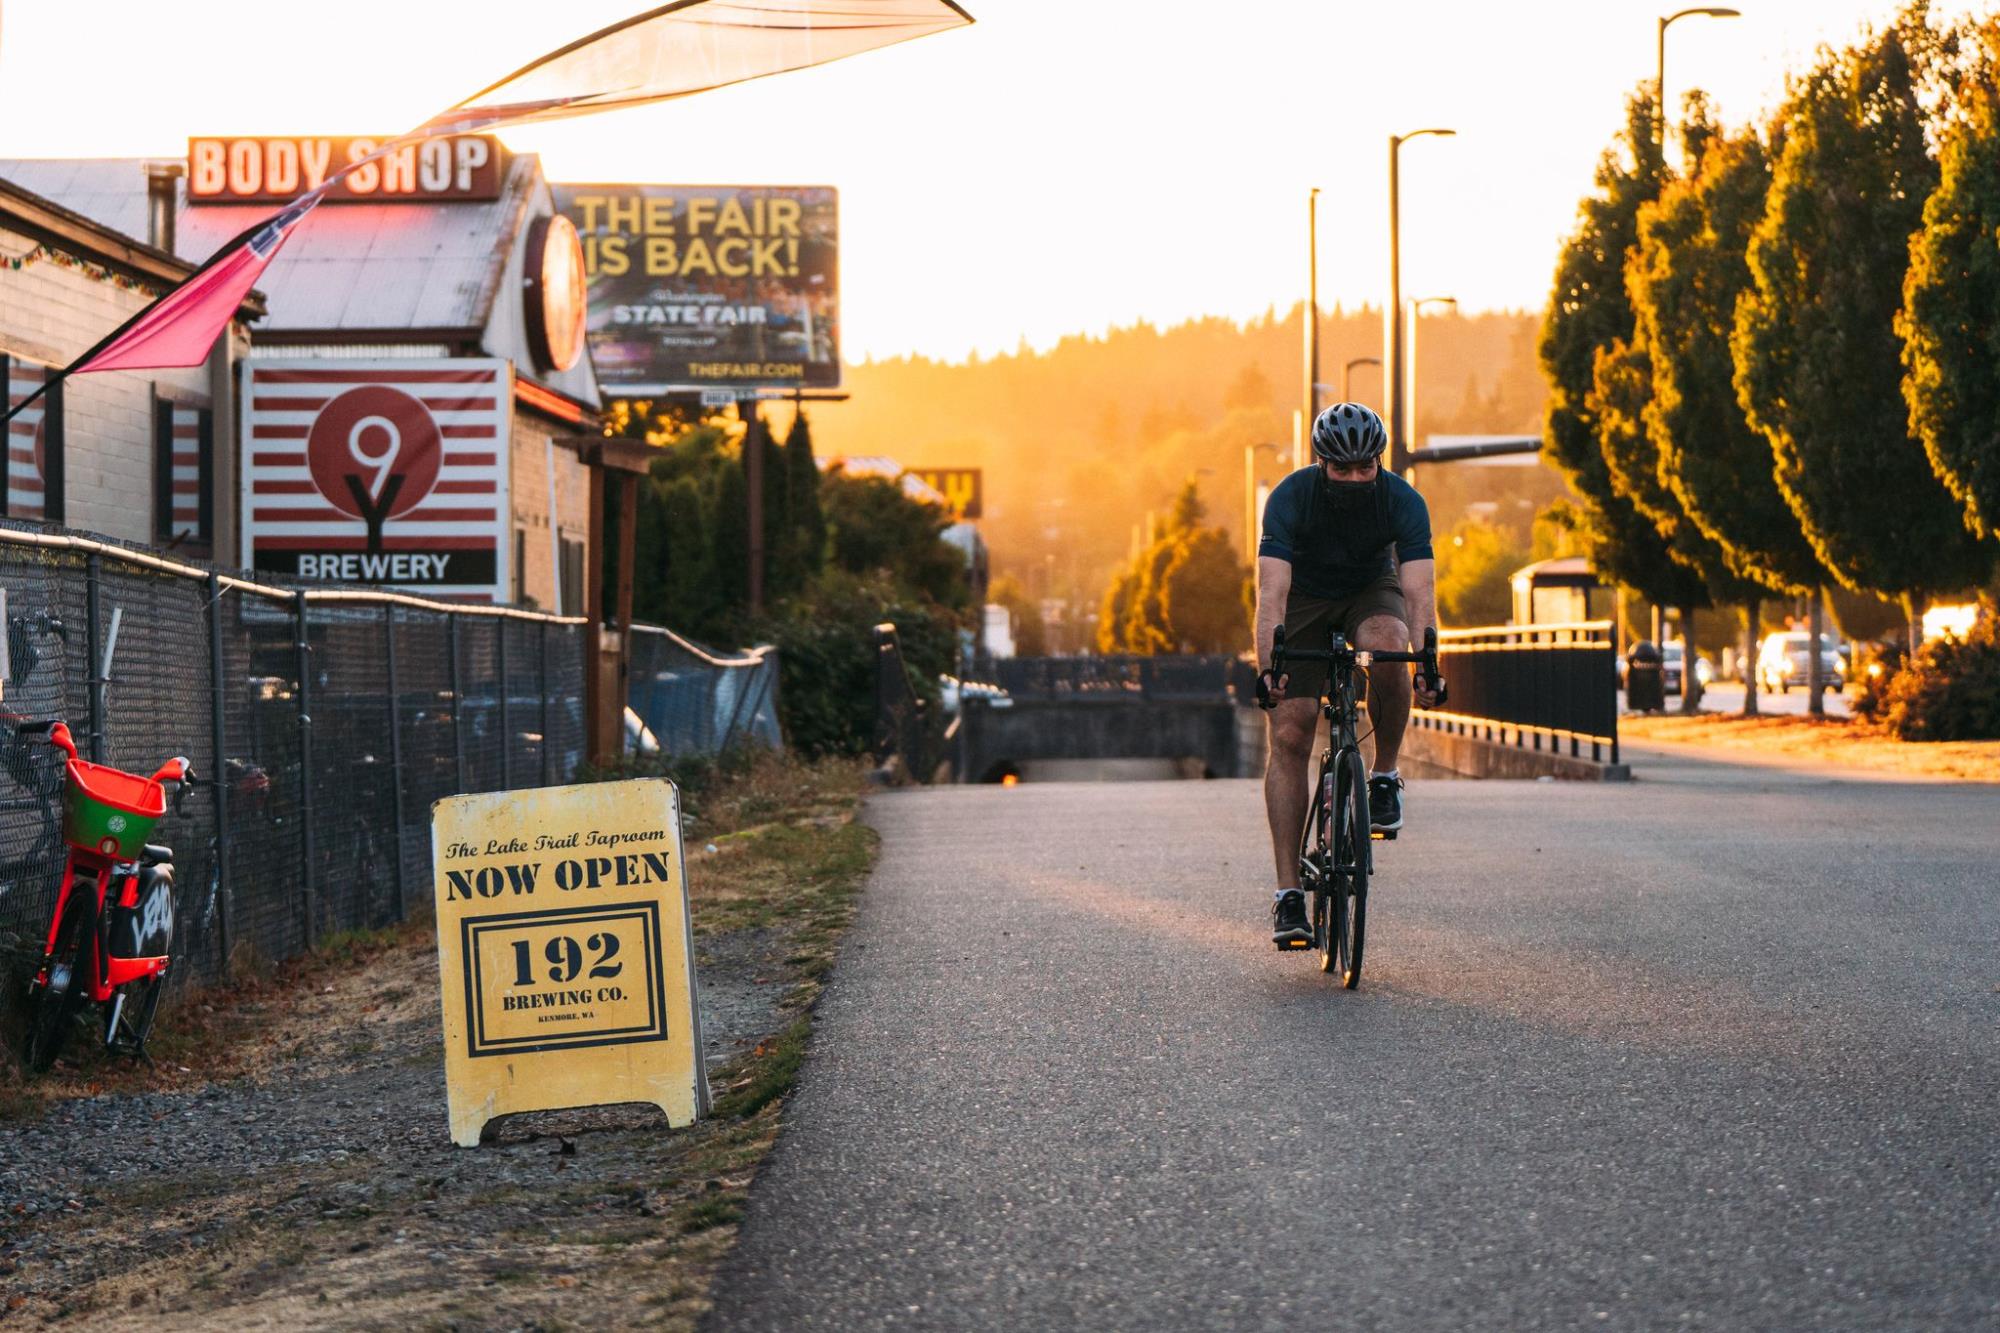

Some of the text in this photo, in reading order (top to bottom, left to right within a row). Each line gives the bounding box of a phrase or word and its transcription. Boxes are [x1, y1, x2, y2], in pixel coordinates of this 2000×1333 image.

[191, 137, 488, 195] BODY SHOP
[574, 196, 801, 236] THE FAIR
[586, 237, 799, 277] IS BACK!
[613, 305, 767, 325] STATE FAIR
[688, 363, 804, 378] THEFAIR.COM
[298, 553, 450, 579] BREWERY
[445, 829, 666, 859] The Lake Trail Taproom
[445, 851, 669, 901] NOW OPEN
[511, 932, 623, 986] 192
[503, 986, 628, 1011] BREWING CO.
[538, 1011, 595, 1023] KENMORE, WA
